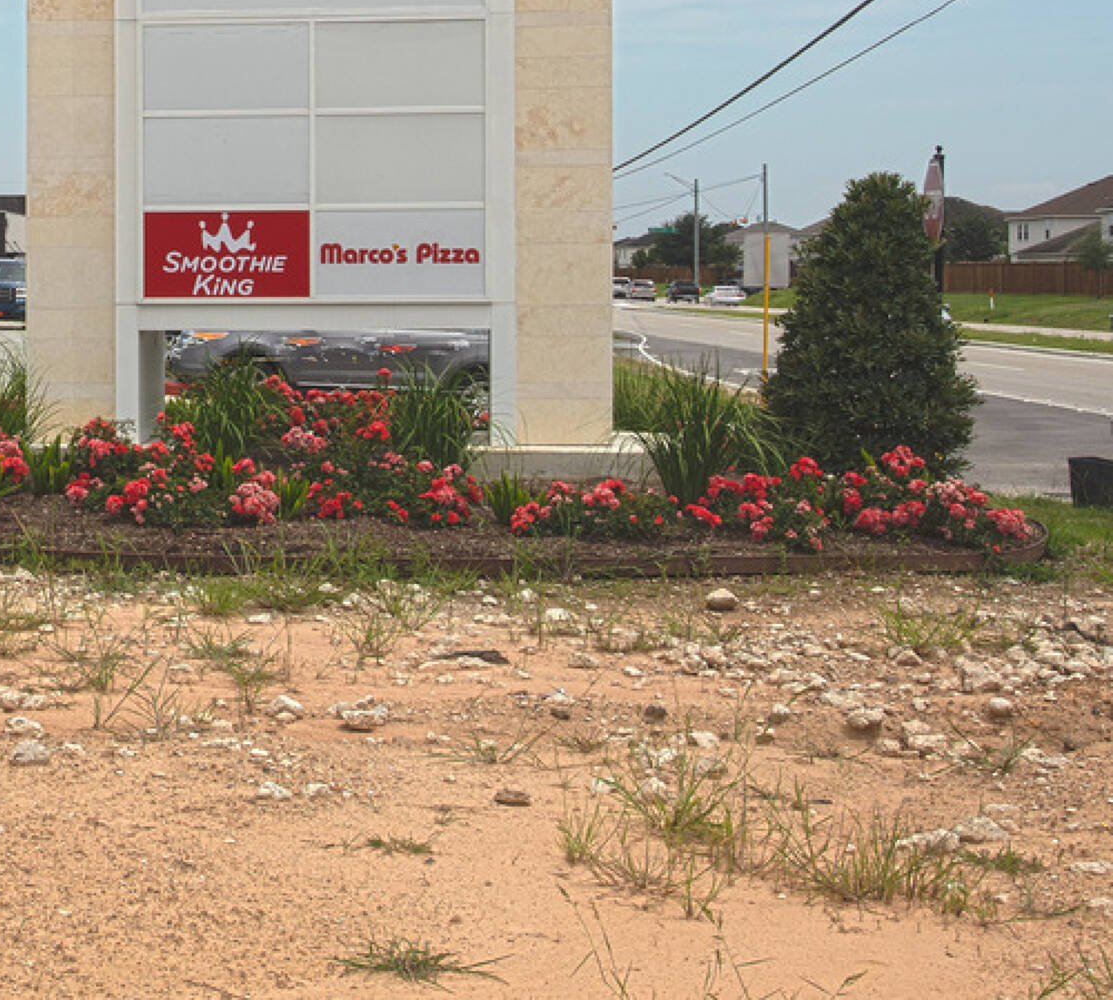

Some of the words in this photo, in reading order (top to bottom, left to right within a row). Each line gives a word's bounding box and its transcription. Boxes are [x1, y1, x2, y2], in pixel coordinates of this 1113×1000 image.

[162, 251, 288, 274] SMOOTHIE
[320, 242, 409, 265] Marco's
[415, 242, 481, 265] Pizza
